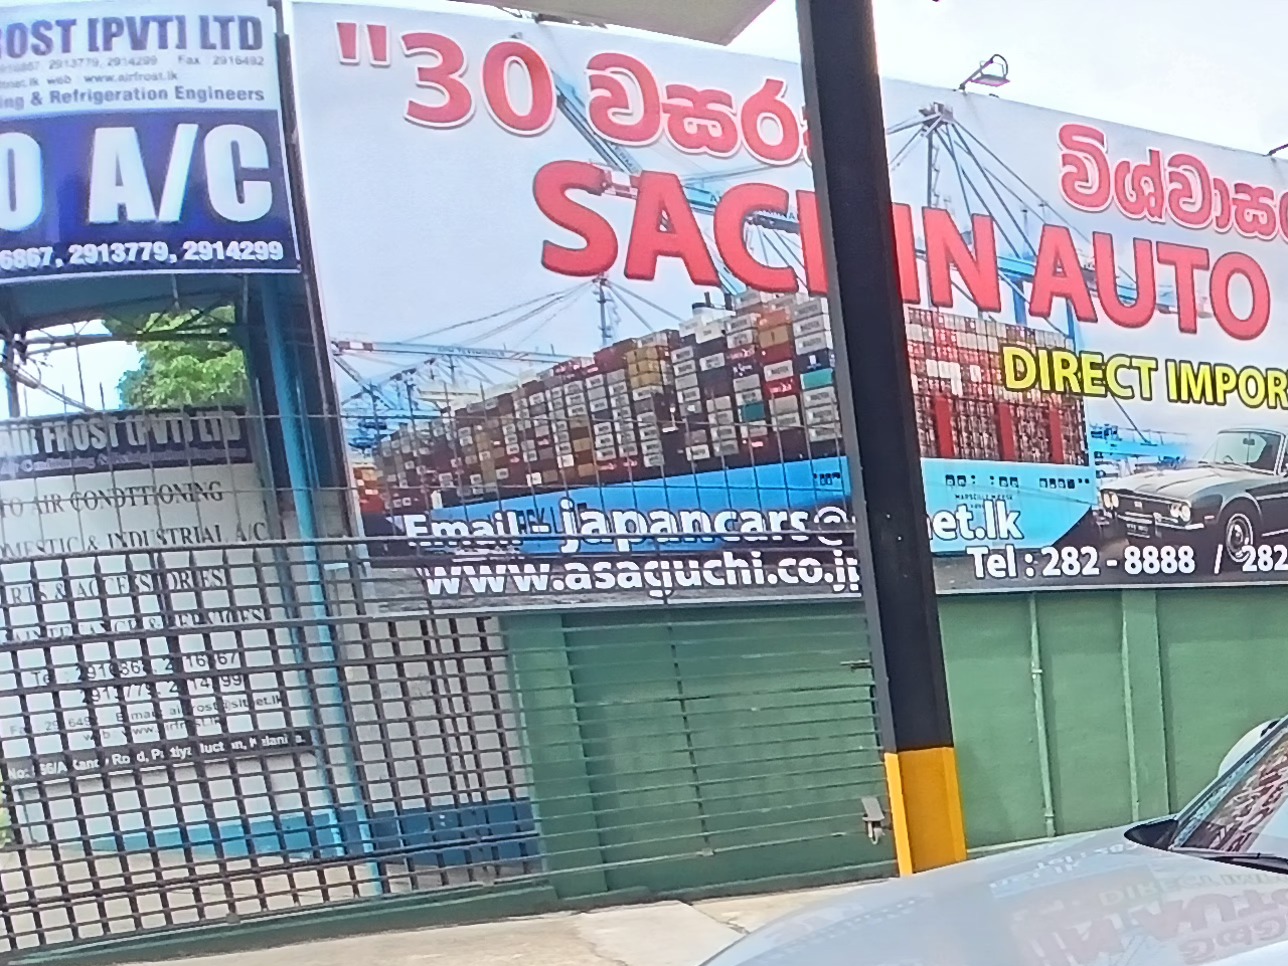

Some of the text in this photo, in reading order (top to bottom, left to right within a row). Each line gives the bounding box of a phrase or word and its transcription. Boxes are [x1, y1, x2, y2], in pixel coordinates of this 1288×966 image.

[0, 19, 77, 59] OST
[199, 15, 263, 50] LTD
[30, 90, 43, 106] &
[50, 87, 168, 106] Refrigeration
[174, 85, 265, 103] Engineers
[585, 52, 815, 167] වසර
[88, 123, 273, 224] A/C
[183, 240, 284, 261] 2914299
[532, 158, 1271, 342] SACIN AUTO
[1002, 346, 1158, 401] DIRECT
[42, 416, 119, 454] FROST
[84, 535, 99, 551] &
[403, 513, 523, 547] Email
[971, 546, 1016, 580] Tel
[1041, 546, 1100, 577] 282
[1124, 546, 1195, 575] 8888
[1242, 545, 1288, 573] 282
[55, 579, 67, 600] &
